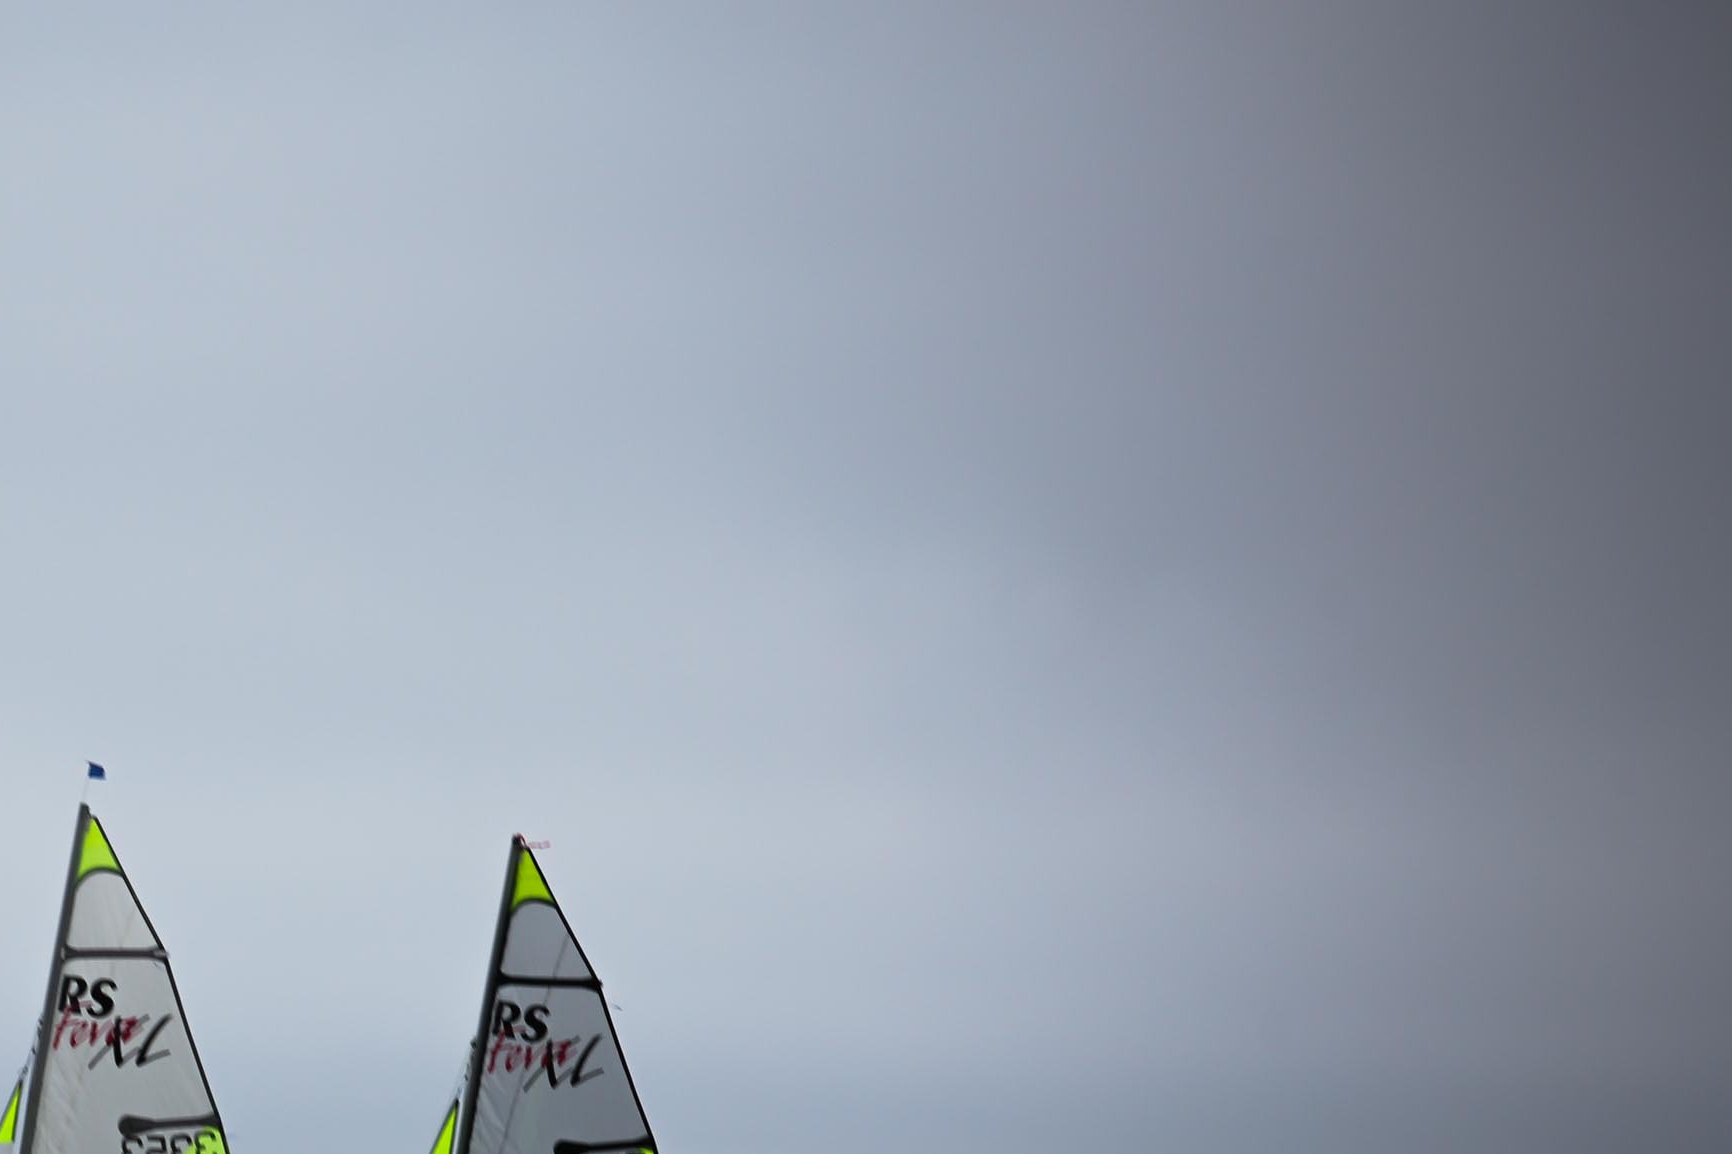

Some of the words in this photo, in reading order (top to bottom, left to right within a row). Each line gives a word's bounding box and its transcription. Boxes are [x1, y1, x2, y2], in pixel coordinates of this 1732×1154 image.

[58, 975, 118, 1019] RS
[88, 1014, 172, 1069] XL
[493, 1001, 551, 1043] RS
[524, 1034, 605, 1092] XL
